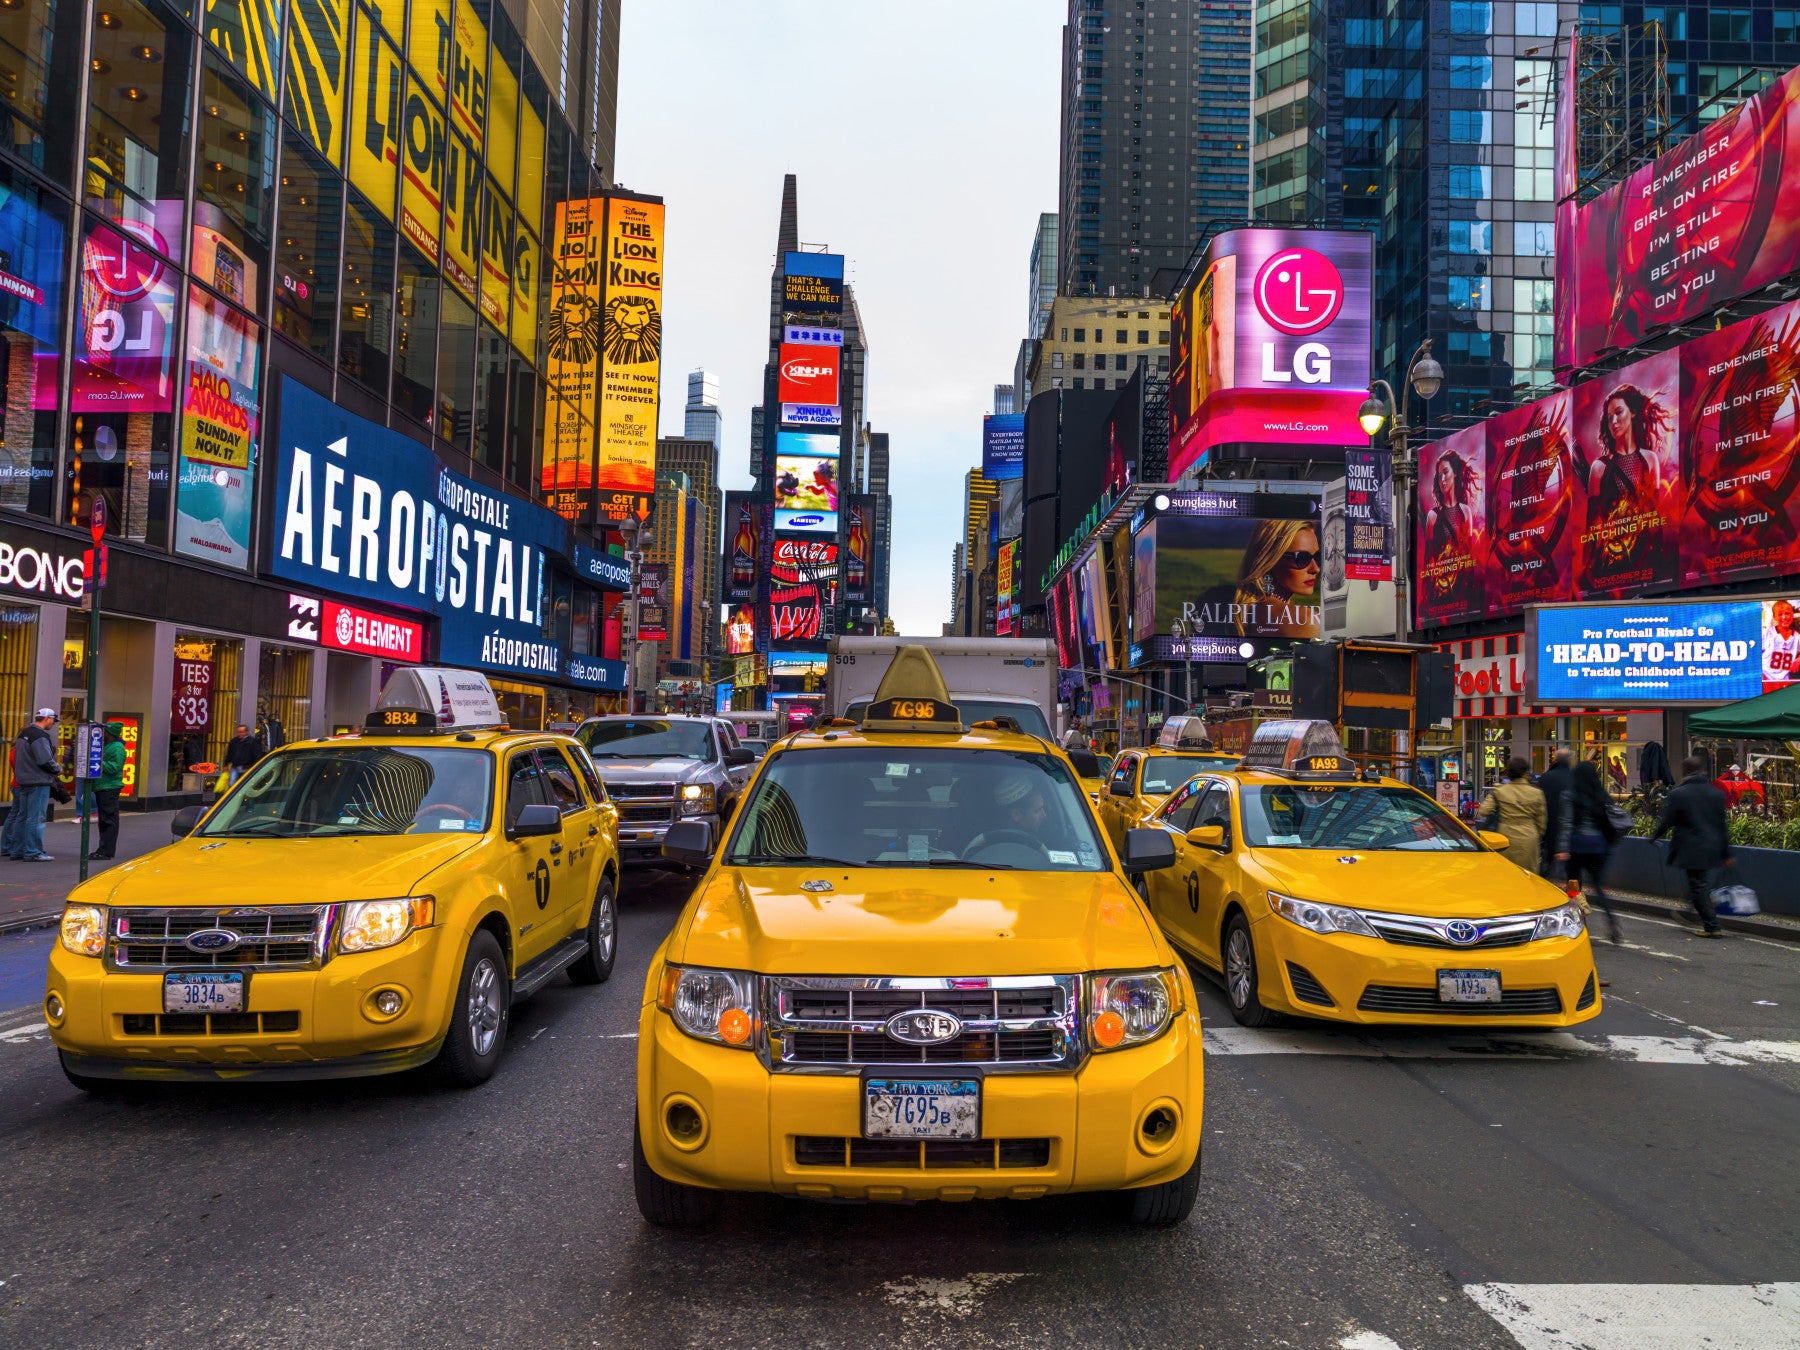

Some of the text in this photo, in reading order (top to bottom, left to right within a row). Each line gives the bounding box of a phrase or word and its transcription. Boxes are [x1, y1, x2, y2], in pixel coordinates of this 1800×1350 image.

[435, 9, 484, 130] THE
[365, 3, 459, 214] LION
[1642, 135, 1730, 199] REMEMBER
[1634, 161, 1740, 232] GIRL ON FIRE
[461, 132, 531, 299] KING
[619, 221, 651, 237] THE
[1649, 205, 1722, 253] I'M STILL
[404, 211, 438, 256] ENTRANCE
[446, 258, 457, 275] ON
[614, 237, 657, 259] LION
[1651, 236, 1720, 281] BETTING
[610, 261, 661, 286] KING
[786, 276, 813, 285] THAT'S
[786, 284, 830, 295] CHALLENGE
[786, 292, 840, 303] WE CAN MEET
[1655, 269, 1715, 309] ON YOU
[1262, 342, 1332, 383] LG
[1708, 343, 1779, 376] REMEMBER
[605, 371, 619, 379] SEE
[633, 375, 658, 383] NOW.
[789, 365, 832, 376] XINHUA
[189, 361, 231, 402] HALO
[607, 385, 653, 395] REMEMBER
[616, 395, 657, 405] FOREVER.
[1703, 382, 1785, 417] GIRL ON FIRE
[187, 385, 248, 432] AWARDS
[796, 407, 832, 416] XINHUA
[610, 422, 648, 431] MINSKOFF
[787, 414, 840, 423] NEWS AGENCY
[1263, 422, 1329, 432] www.LG.com
[197, 420, 241, 447] SUNDAY
[1504, 426, 1550, 448] REMEMBER
[1715, 429, 1771, 452] I'M STILL
[195, 437, 234, 461] NOV. 17
[1348, 465, 1375, 478] SOME
[1502, 458, 1554, 480] GIRL ON FIRE
[1348, 478, 1379, 491] WALLS
[1715, 470, 1771, 492] BETTING
[438, 466, 509, 530] AÉROPOSTALE
[613, 494, 635, 504] GET
[1172, 498, 1237, 510] sunglass hut
[1348, 492, 1367, 504] CAN
[1509, 493, 1545, 510] I'M STILL
[1348, 505, 1370, 517] TALK
[1604, 516, 1631, 529] HUNGER
[1633, 511, 1658, 522] GAMES
[1719, 511, 1768, 531] ON YOU
[281, 437, 545, 627] AÉROPOSTAL
[1354, 525, 1384, 538] SPOTLIGHT
[1509, 526, 1545, 541] BETTING
[1580, 516, 1667, 544] CATCHING FIRE
[190, 537, 232, 553] #HALOAWARDS
[1354, 539, 1384, 549] BROADWAY
[1000, 546, 1011, 561] THE
[0, 542, 83, 598] BONG
[1420, 559, 1477, 578] CATCHING FIRE
[1511, 559, 1542, 573] ON YOU
[1183, 602, 1256, 624] RALPH
[354, 616, 412, 652] ELEMENT
[1583, 627, 1714, 639] Pro Football Rivals Go
[481, 628, 558, 673] AÉROPOSTALE
[1192, 643, 1237, 657] sunglass
[836, 655, 856, 665] 505
[181, 663, 209, 683] TEES
[1567, 666, 1731, 677] to Tackle Childhood Cancer
[187, 685, 202, 695] 3 for
[179, 697, 208, 725] $33
[384, 711, 418, 725] 3B34
[892, 701, 935, 718] 7G95
[1310, 758, 1339, 770] 1A93
[197, 937, 223, 947] Ford
[186, 976, 224, 984] NEW YORK
[922, 1084, 950, 1095] YORK
